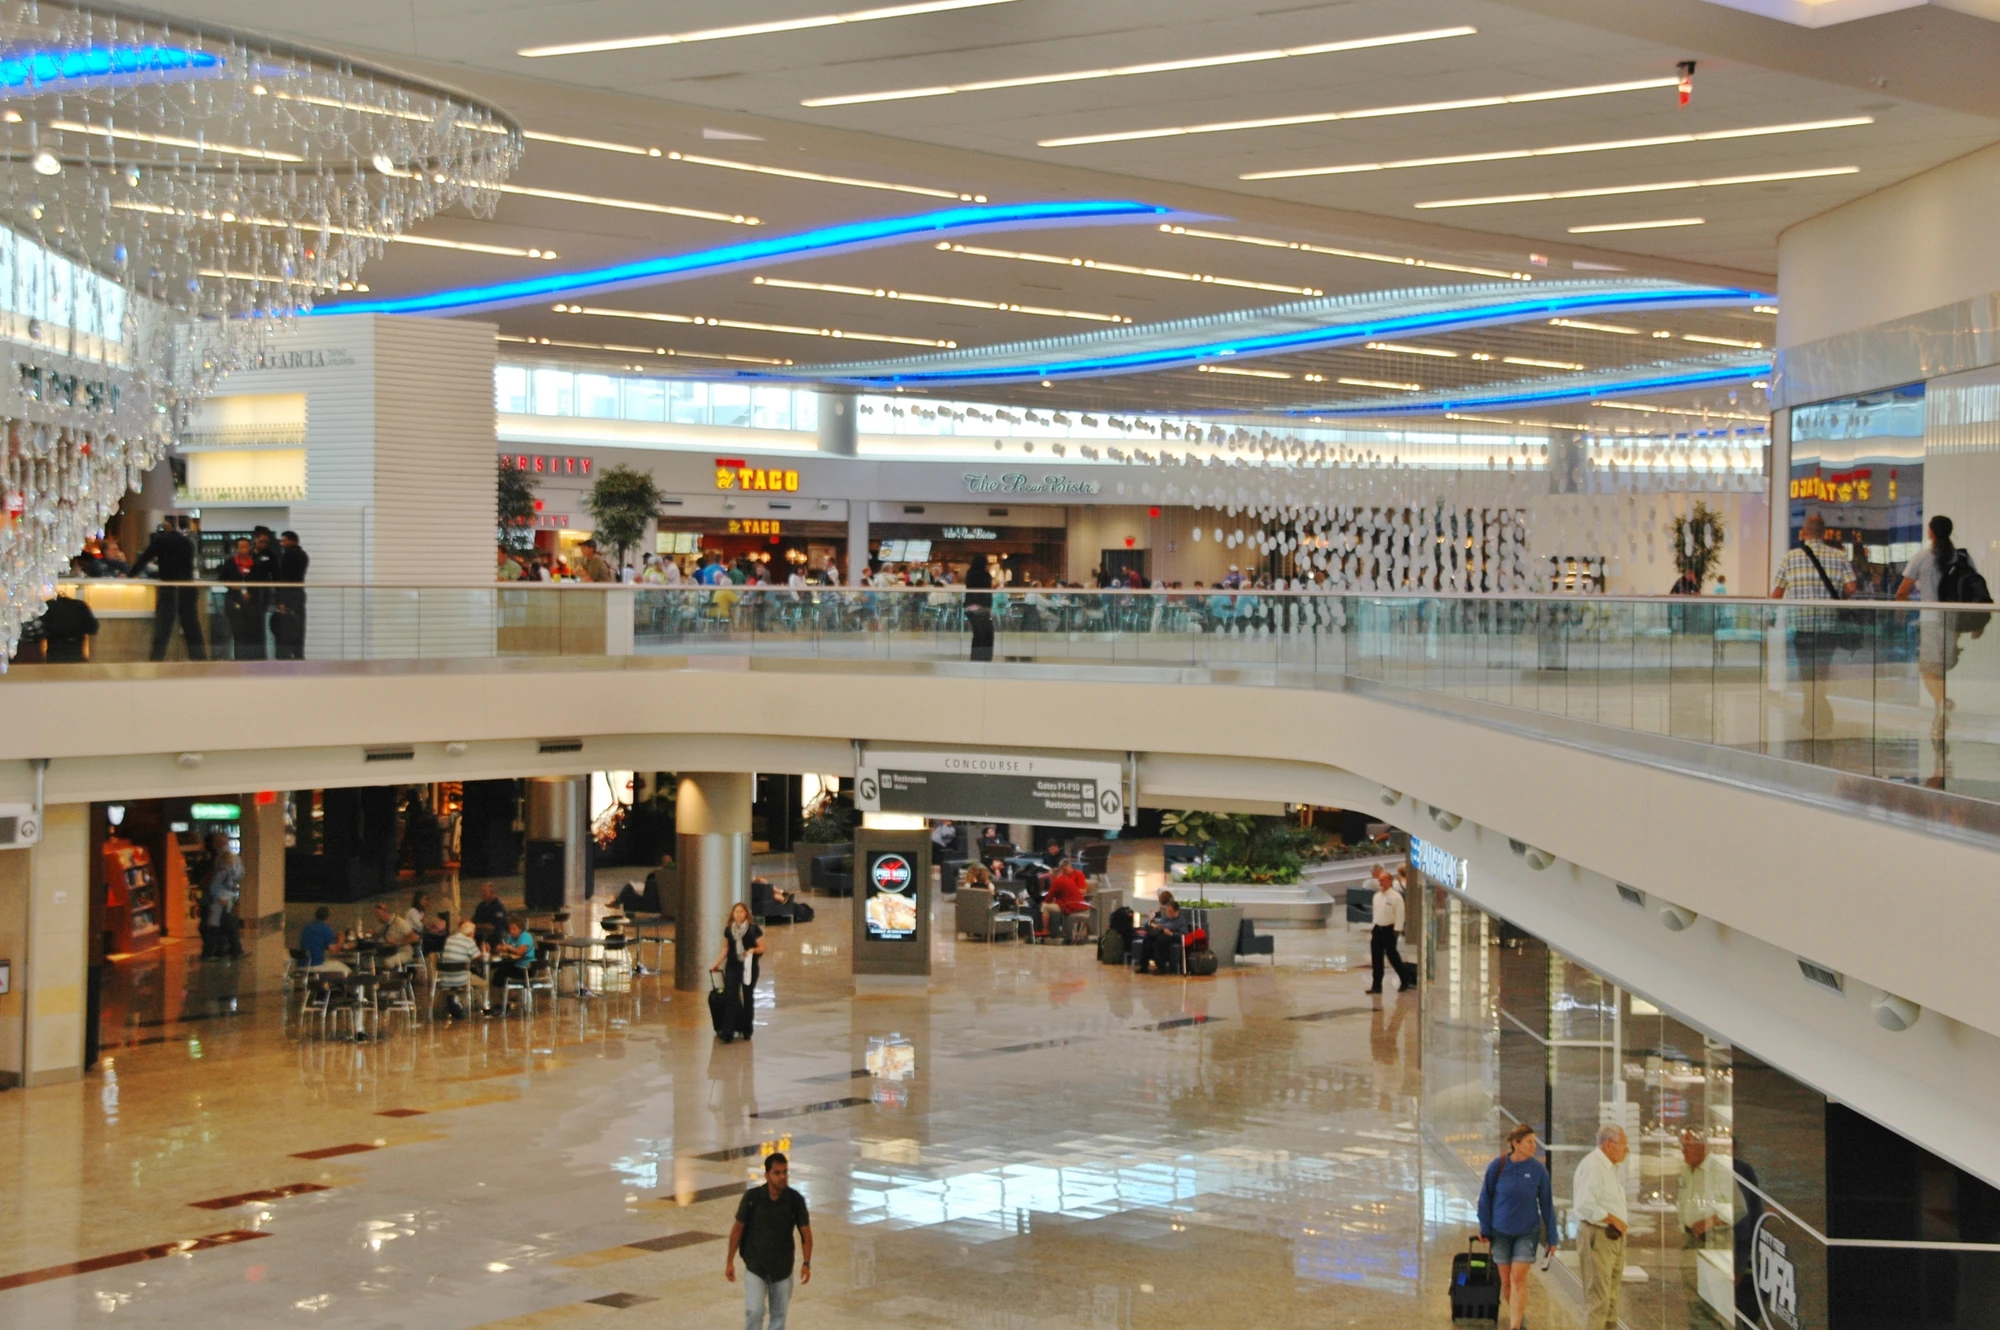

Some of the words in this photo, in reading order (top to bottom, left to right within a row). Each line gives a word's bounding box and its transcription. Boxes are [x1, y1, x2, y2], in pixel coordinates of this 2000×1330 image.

[738, 468, 799, 492] TACO
[964, 472, 999, 492] The
[1001, 473, 1047, 493] Pecan
[1044, 476, 1103, 494] Bistr
[742, 520, 780, 534] TACO
[945, 758, 1020, 772] CONCOURSE
[1029, 763, 1035, 771] F
[893, 774, 927, 784] Restrooms
[1037, 781, 1057, 791] Gates
[1058, 783, 1080, 792] F1-F10
[1045, 800, 1081, 810] Restrooms
[1759, 1240, 1797, 1316] DFA
